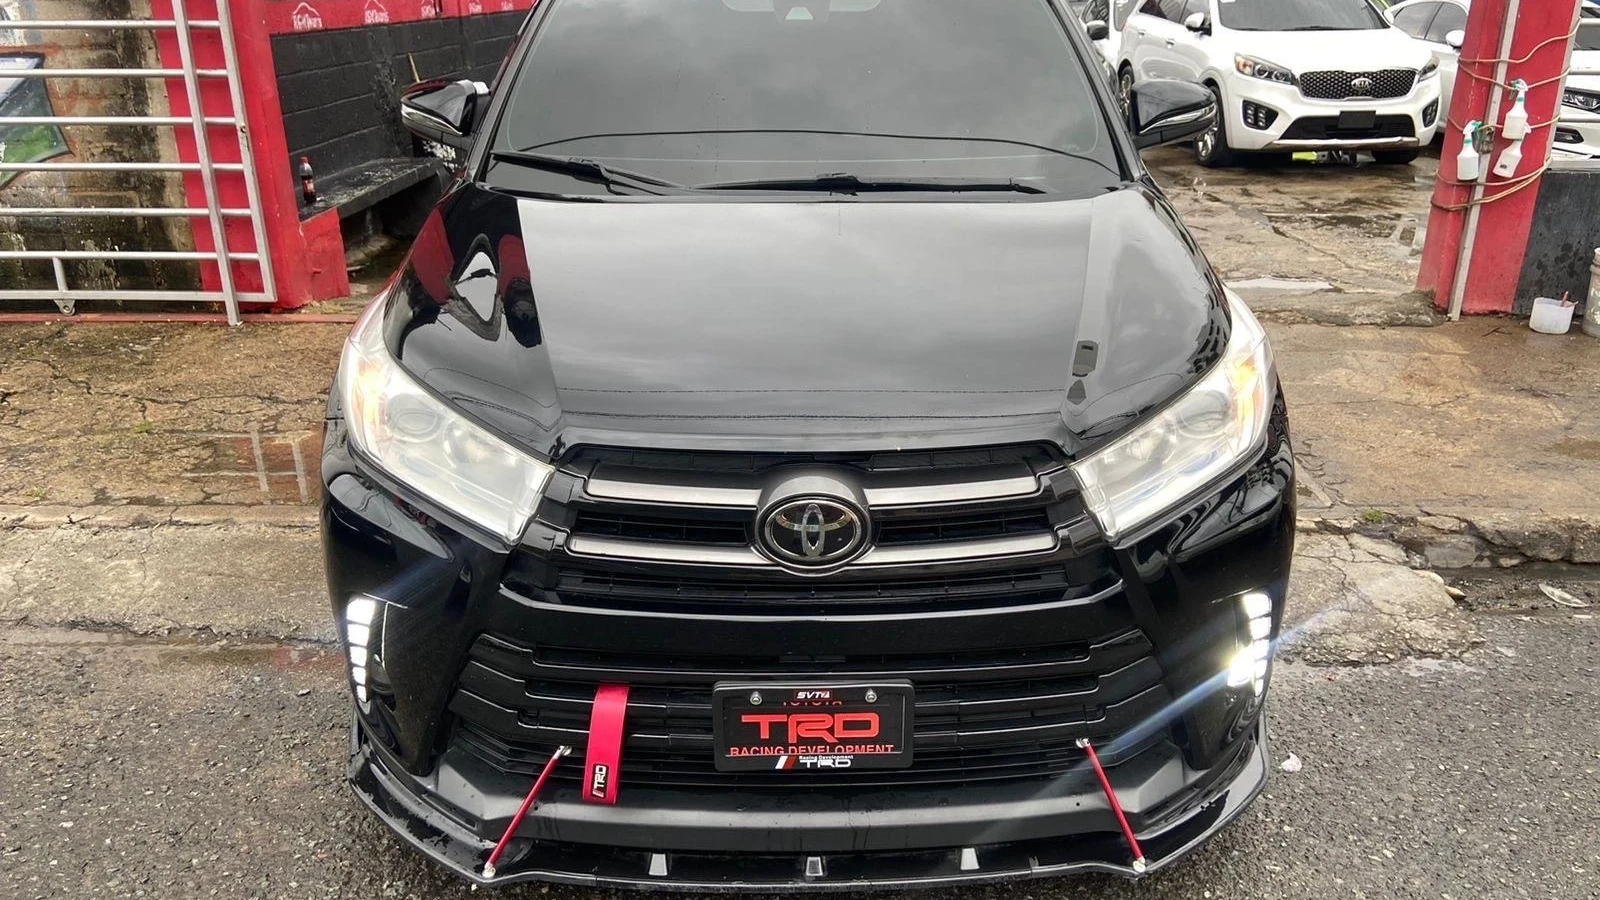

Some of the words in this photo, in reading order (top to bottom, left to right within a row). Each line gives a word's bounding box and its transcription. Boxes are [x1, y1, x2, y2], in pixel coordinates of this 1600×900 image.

[741, 712, 880, 744] TRD
[730, 746, 785, 756] RACING
[789, 744, 895, 755] DEVELOPMENT
[799, 759, 852, 768] TRD
[593, 764, 607, 789] TRD
